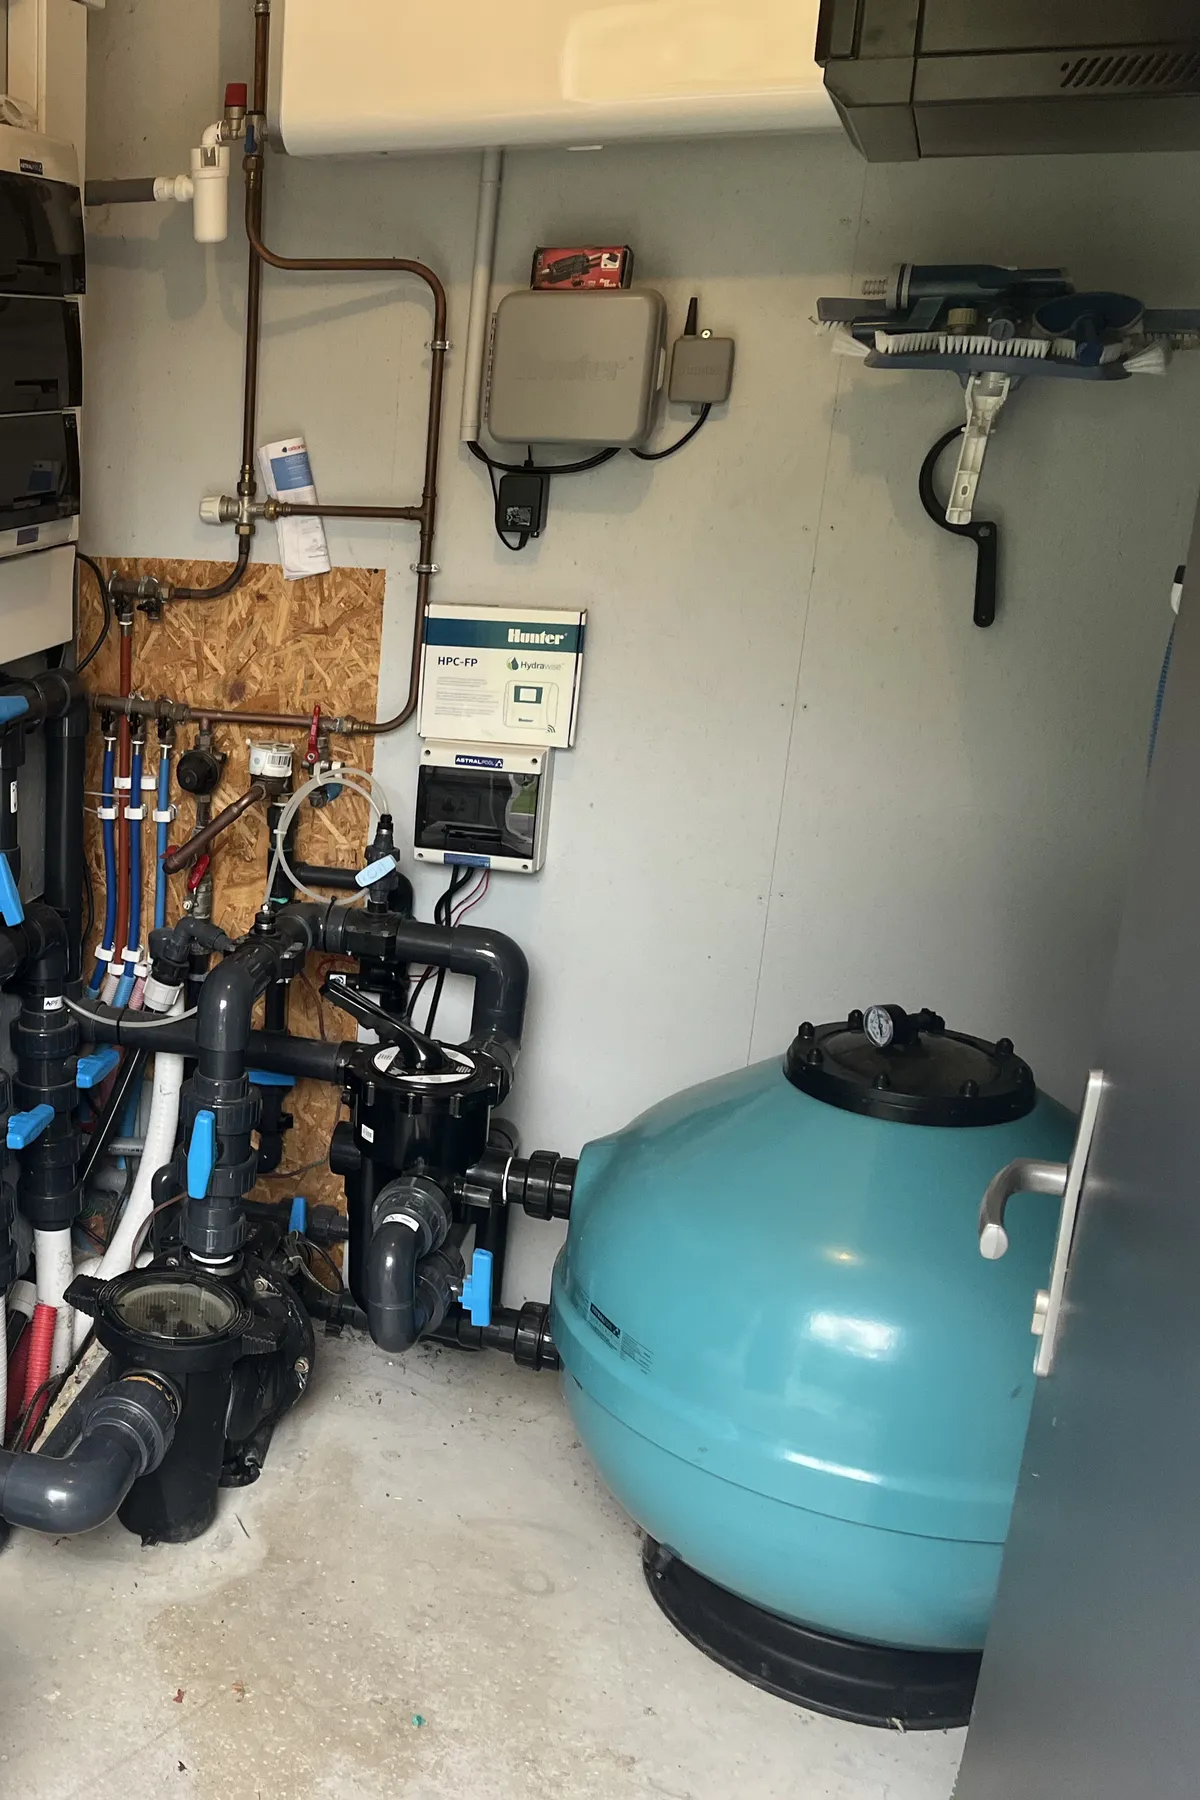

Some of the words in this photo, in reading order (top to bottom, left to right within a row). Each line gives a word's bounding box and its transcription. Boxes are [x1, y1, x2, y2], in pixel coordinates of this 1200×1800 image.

[507, 628, 564, 645] Hunter
[437, 656, 478, 667] HPC-FP
[520, 660, 563, 671] Hydrawise
[455, 757, 495, 766] ASTRALPOOL
